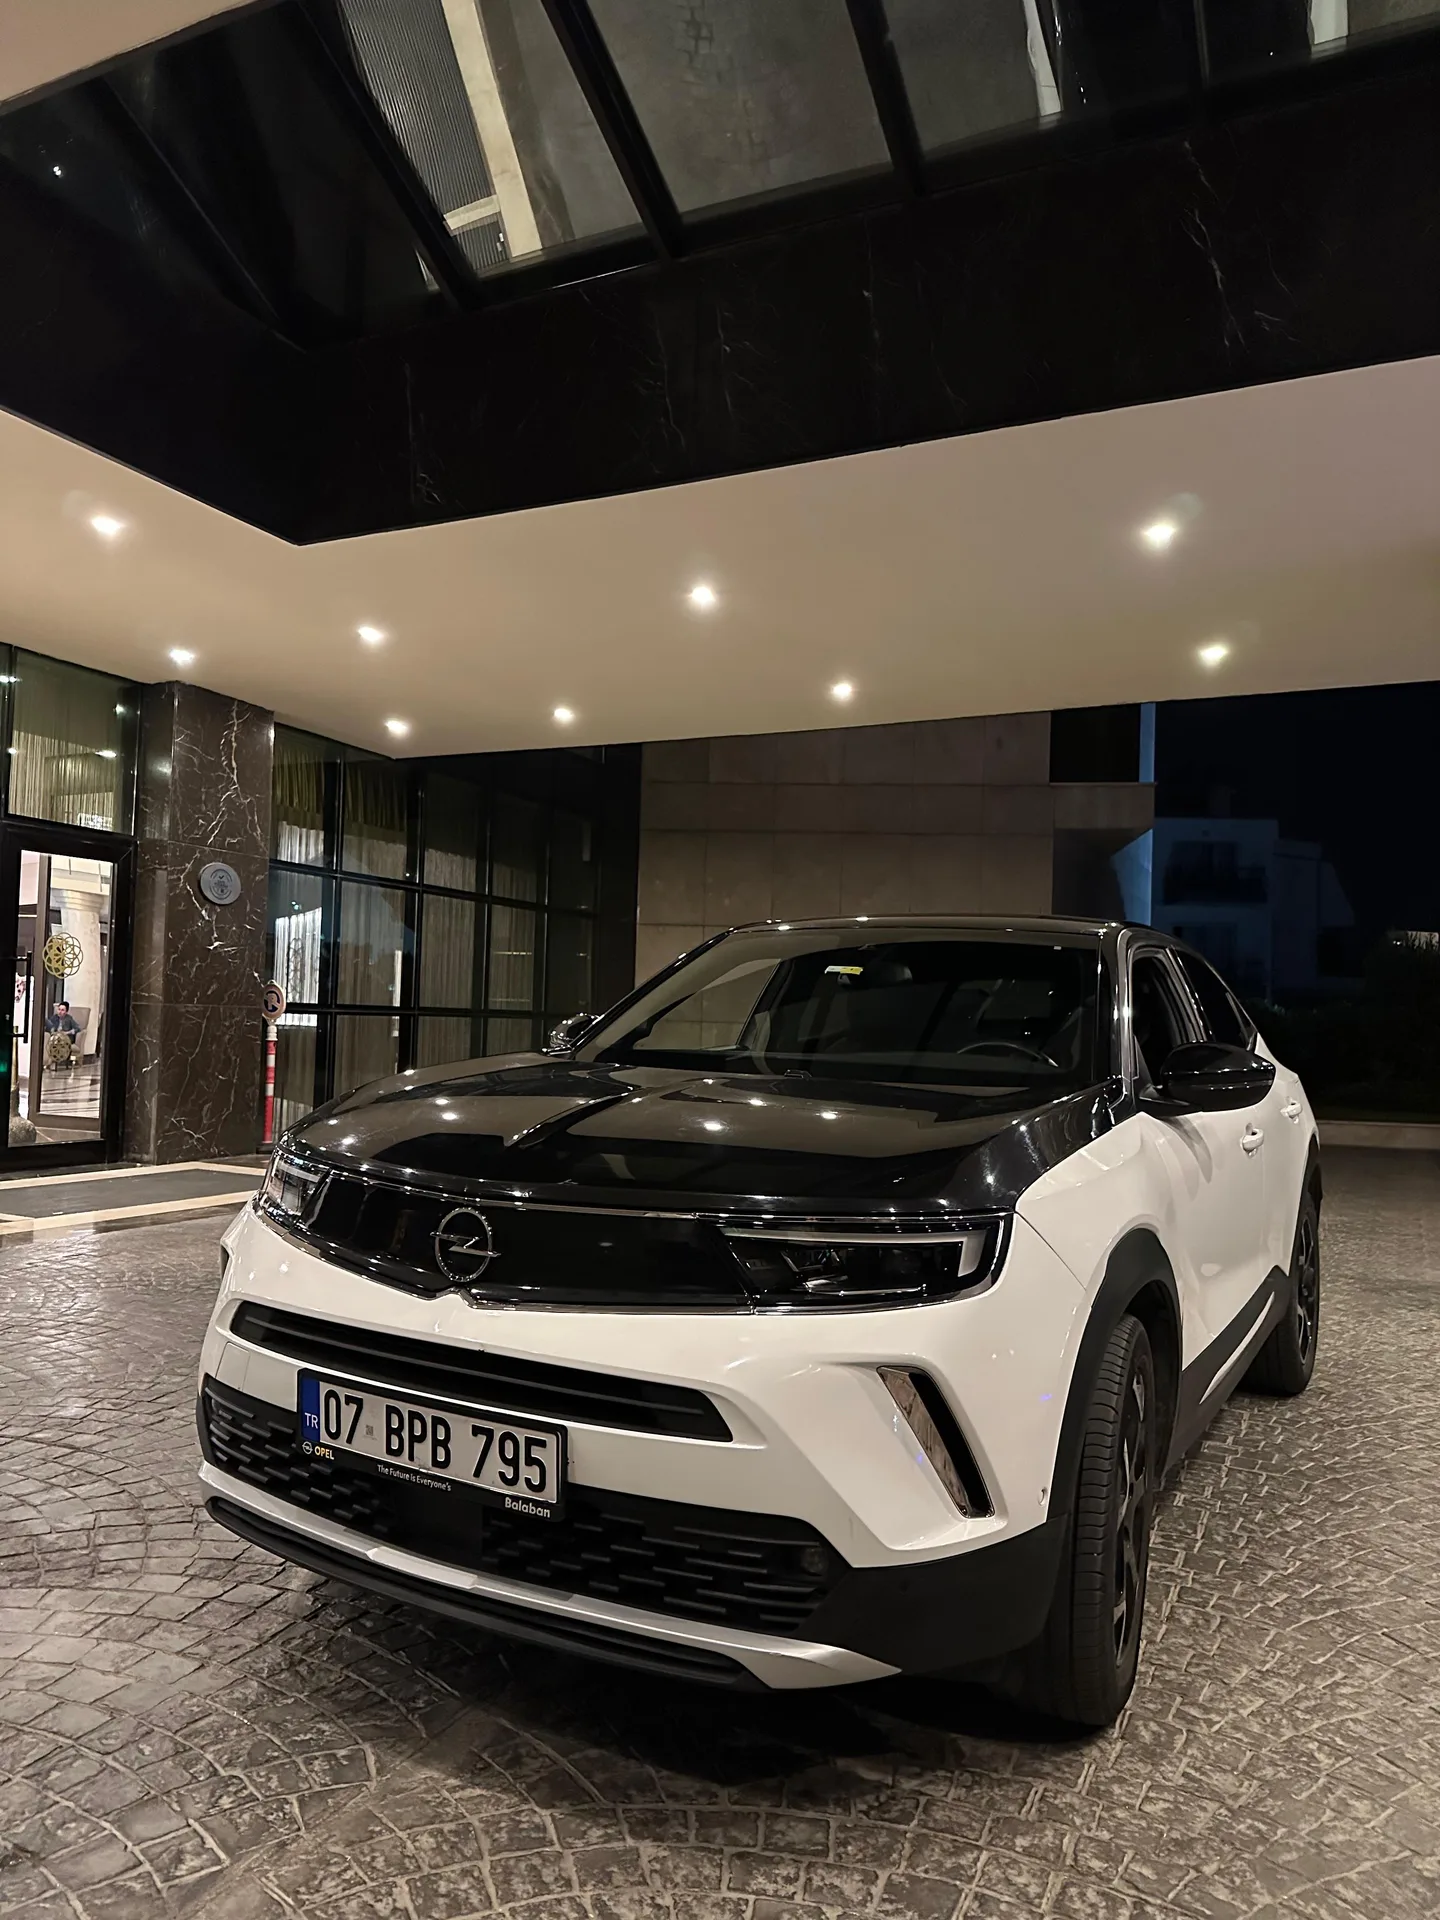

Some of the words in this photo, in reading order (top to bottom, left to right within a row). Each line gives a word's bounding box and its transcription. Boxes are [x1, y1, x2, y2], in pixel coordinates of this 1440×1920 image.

[304, 1412, 319, 1429] TR
[323, 1388, 364, 1445] 07
[385, 1403, 452, 1470] BPB
[471, 1423, 547, 1494] 795
[314, 1446, 335, 1460] OPEL
[377, 1464, 389, 1475] The
[389, 1467, 410, 1481] Future
[416, 1475, 452, 1492] Everyone's
[504, 1496, 551, 1518] Balaban
